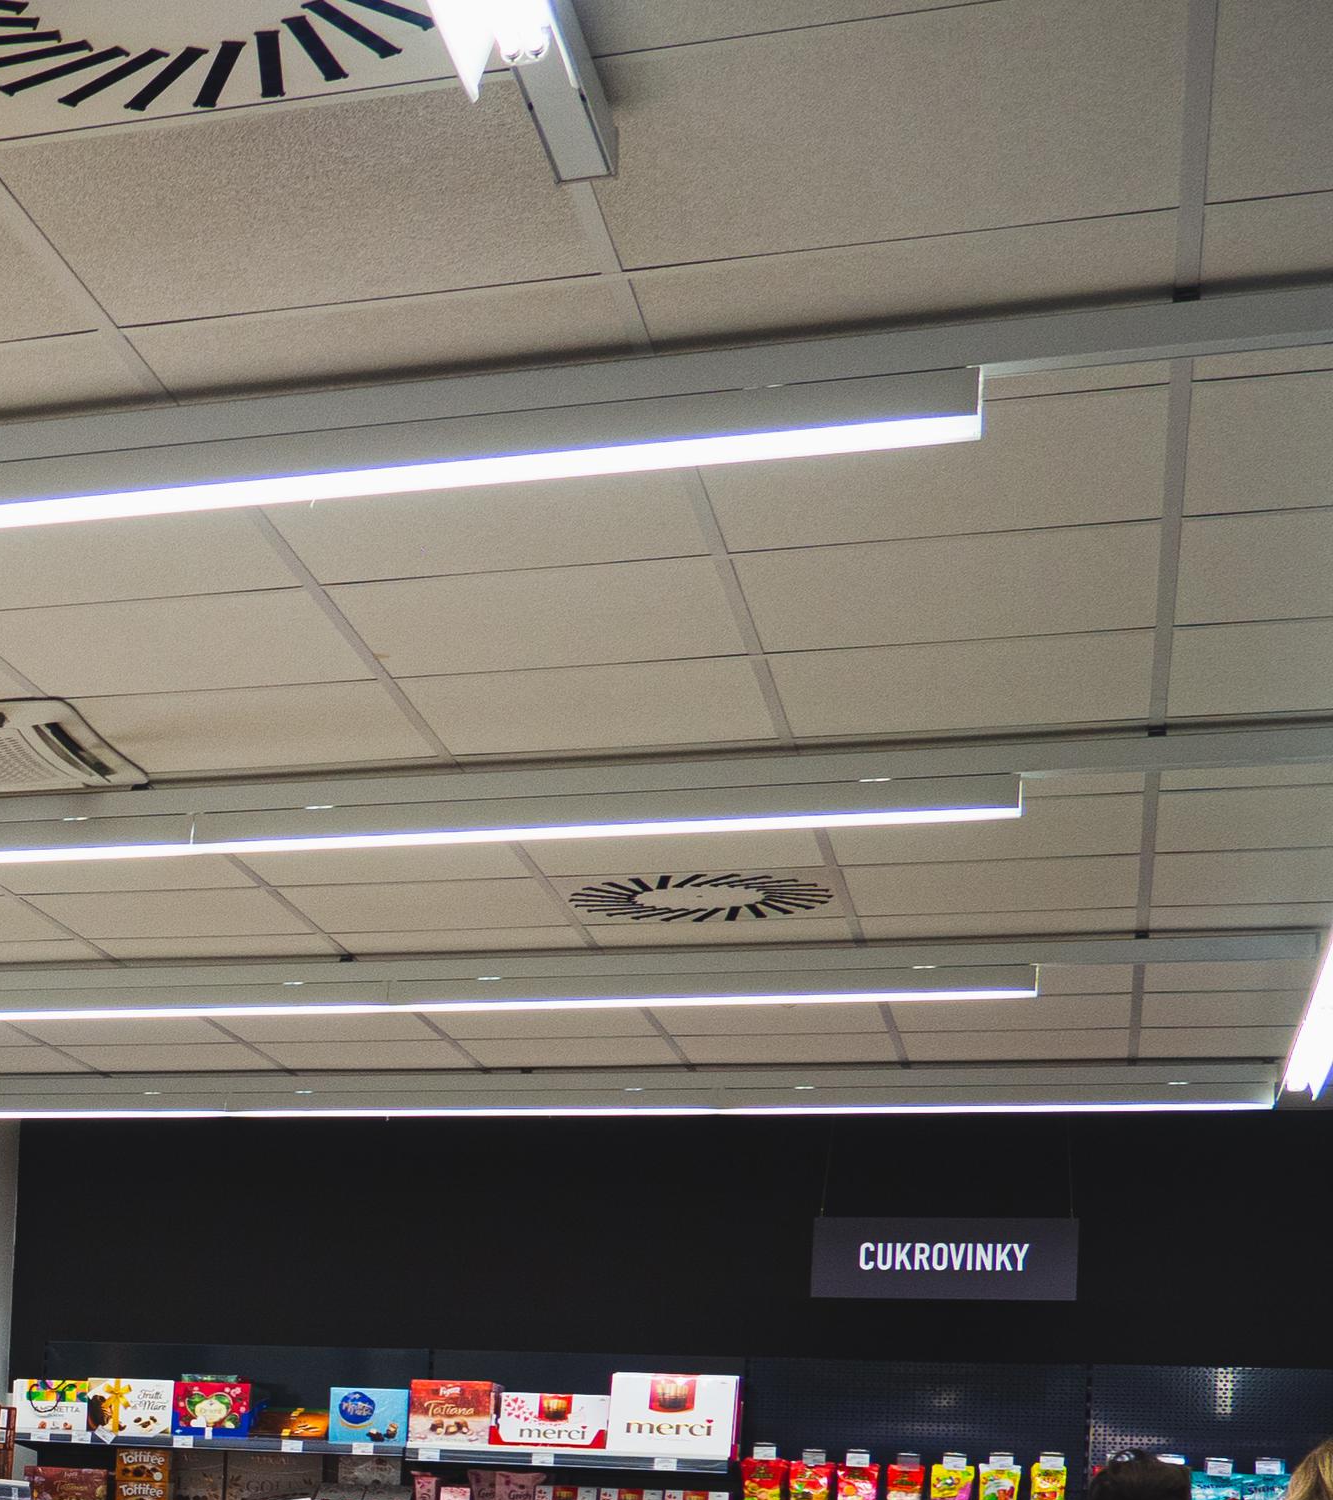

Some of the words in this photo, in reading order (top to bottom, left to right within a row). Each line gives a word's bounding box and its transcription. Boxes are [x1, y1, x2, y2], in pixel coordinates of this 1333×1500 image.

[859, 1242, 1029, 1272] CUKROVINKY
[423, 1399, 476, 1417] Tatiana
[519, 1426, 588, 1441] merci
[626, 1419, 715, 1438] merci
[119, 1451, 166, 1466] Toffifee
[119, 1483, 165, 1498] Toffifee
